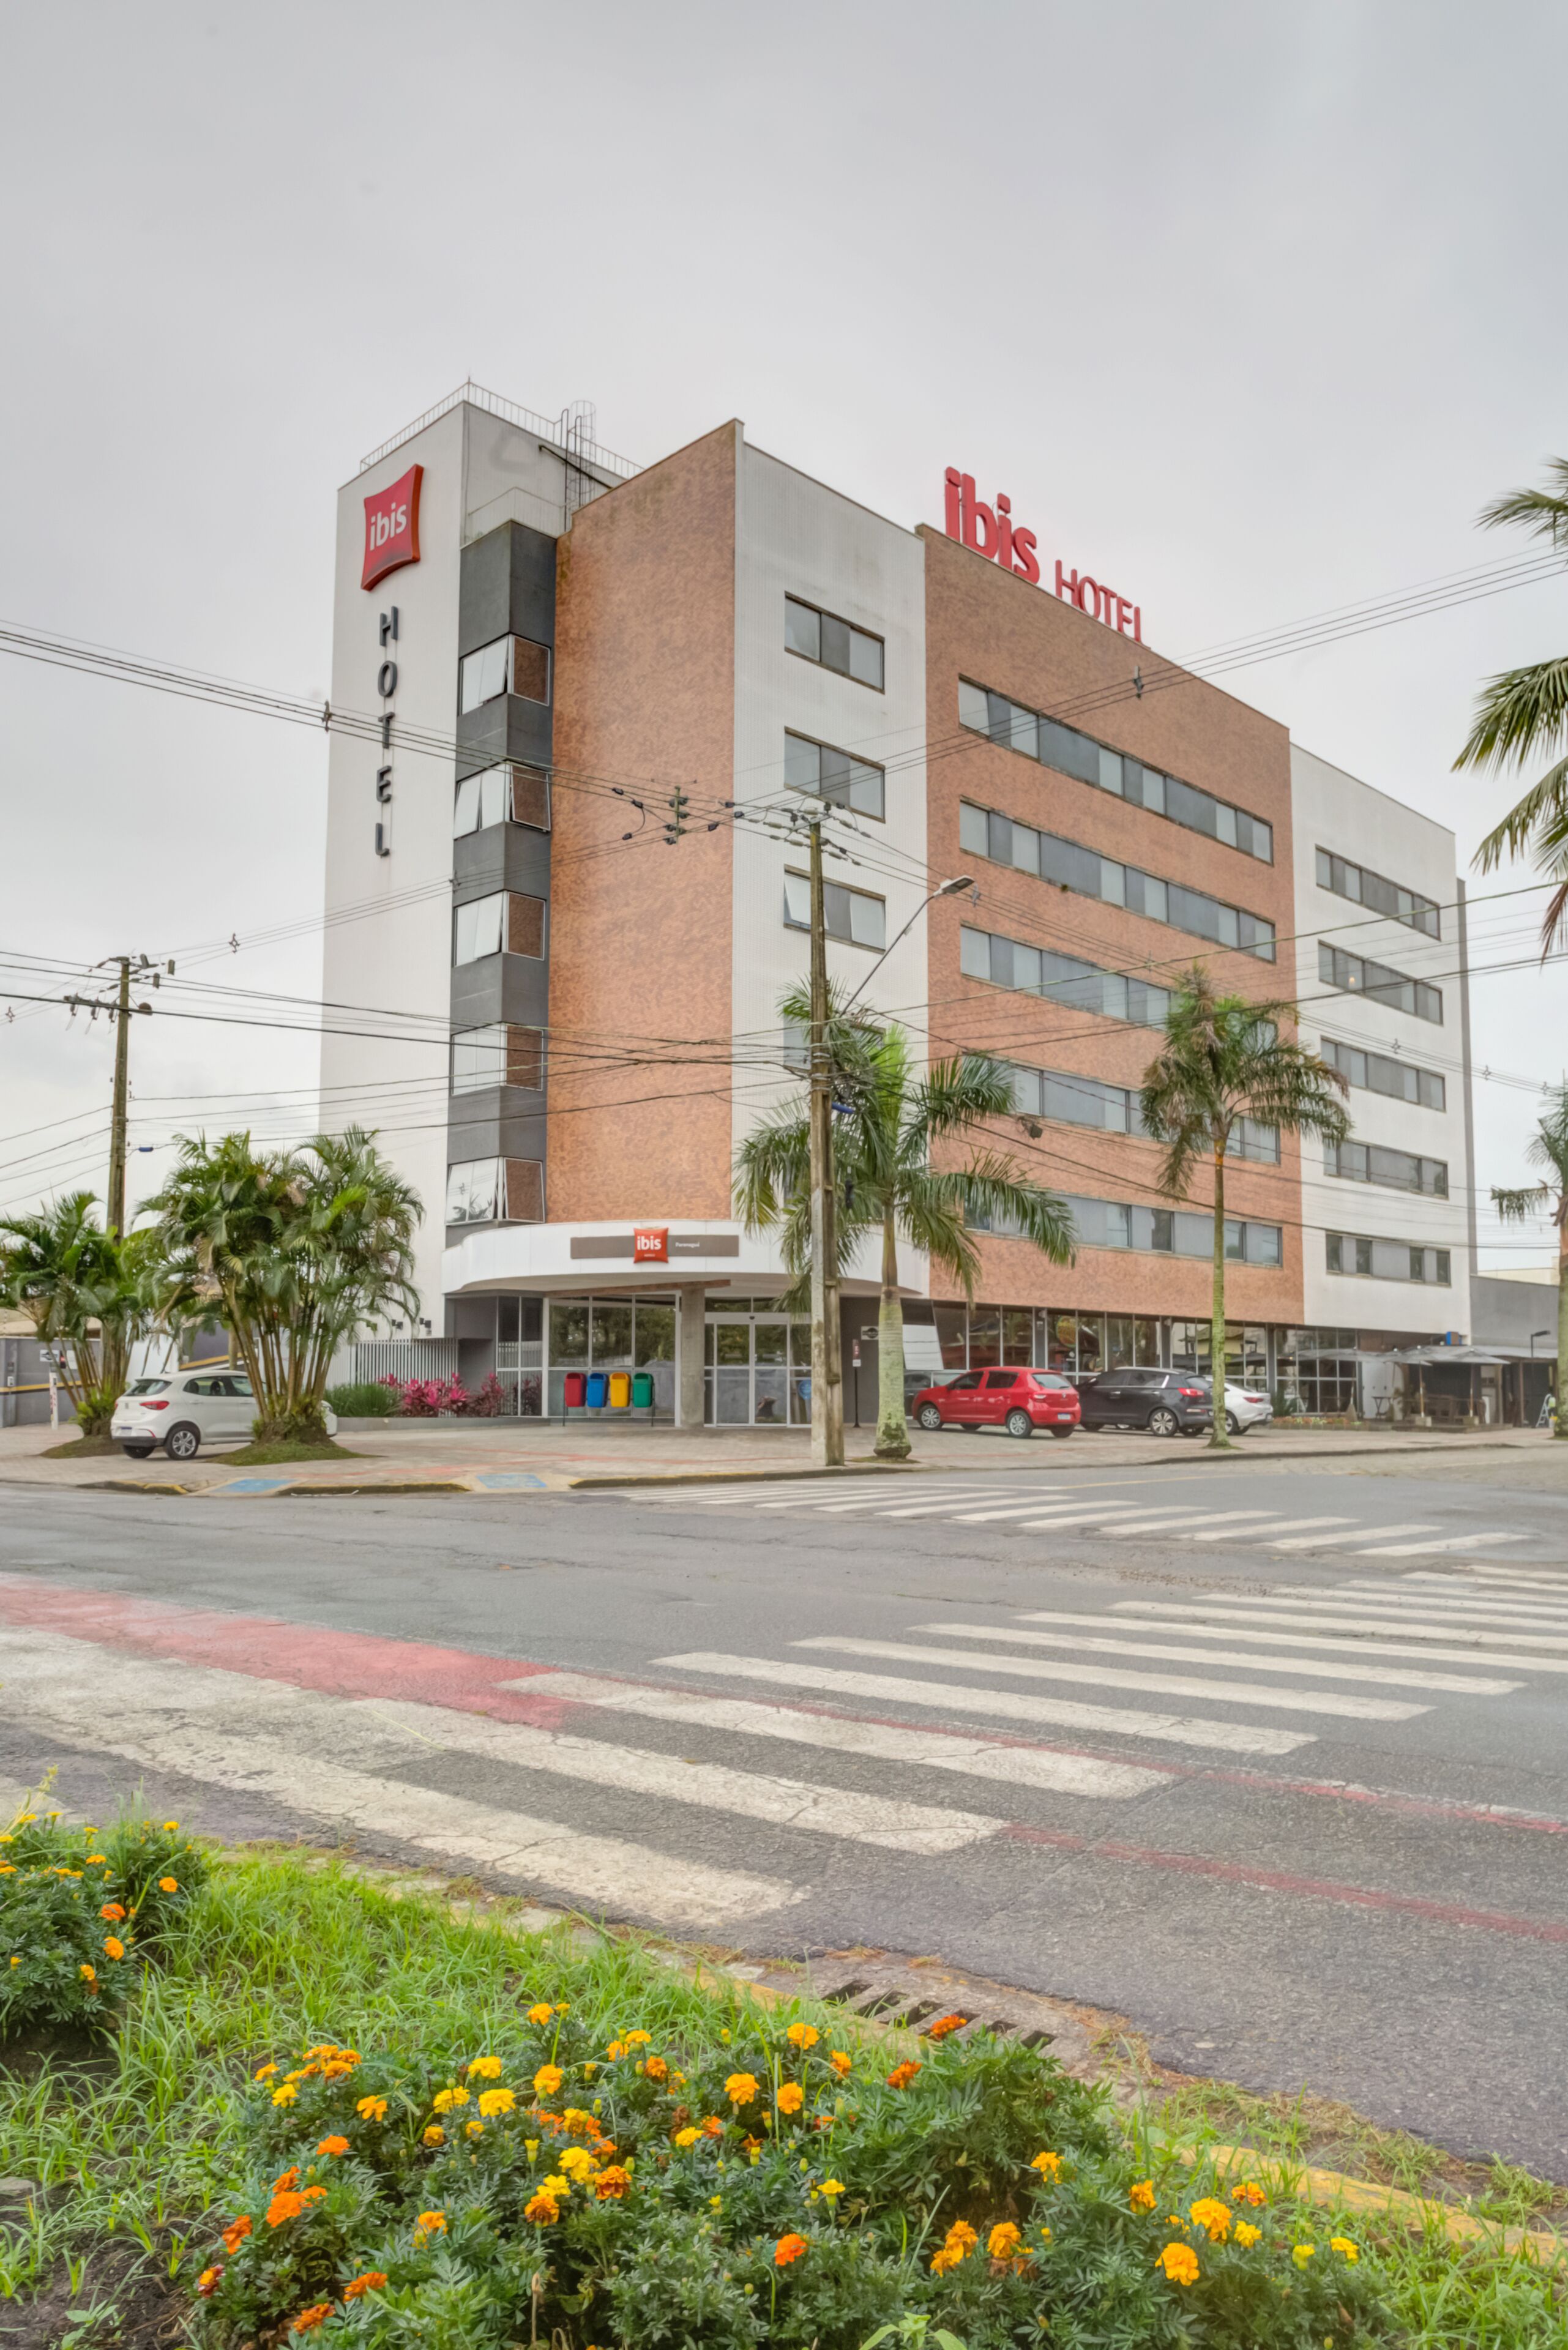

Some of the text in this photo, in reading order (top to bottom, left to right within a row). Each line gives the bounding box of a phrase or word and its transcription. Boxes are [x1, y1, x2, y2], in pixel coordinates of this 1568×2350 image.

[370, 502, 406, 551] ibis
[944, 466, 1149, 649] ibis HOTEL
[375, 605, 398, 857] HOTEL
[637, 1236, 662, 1250] ibis
